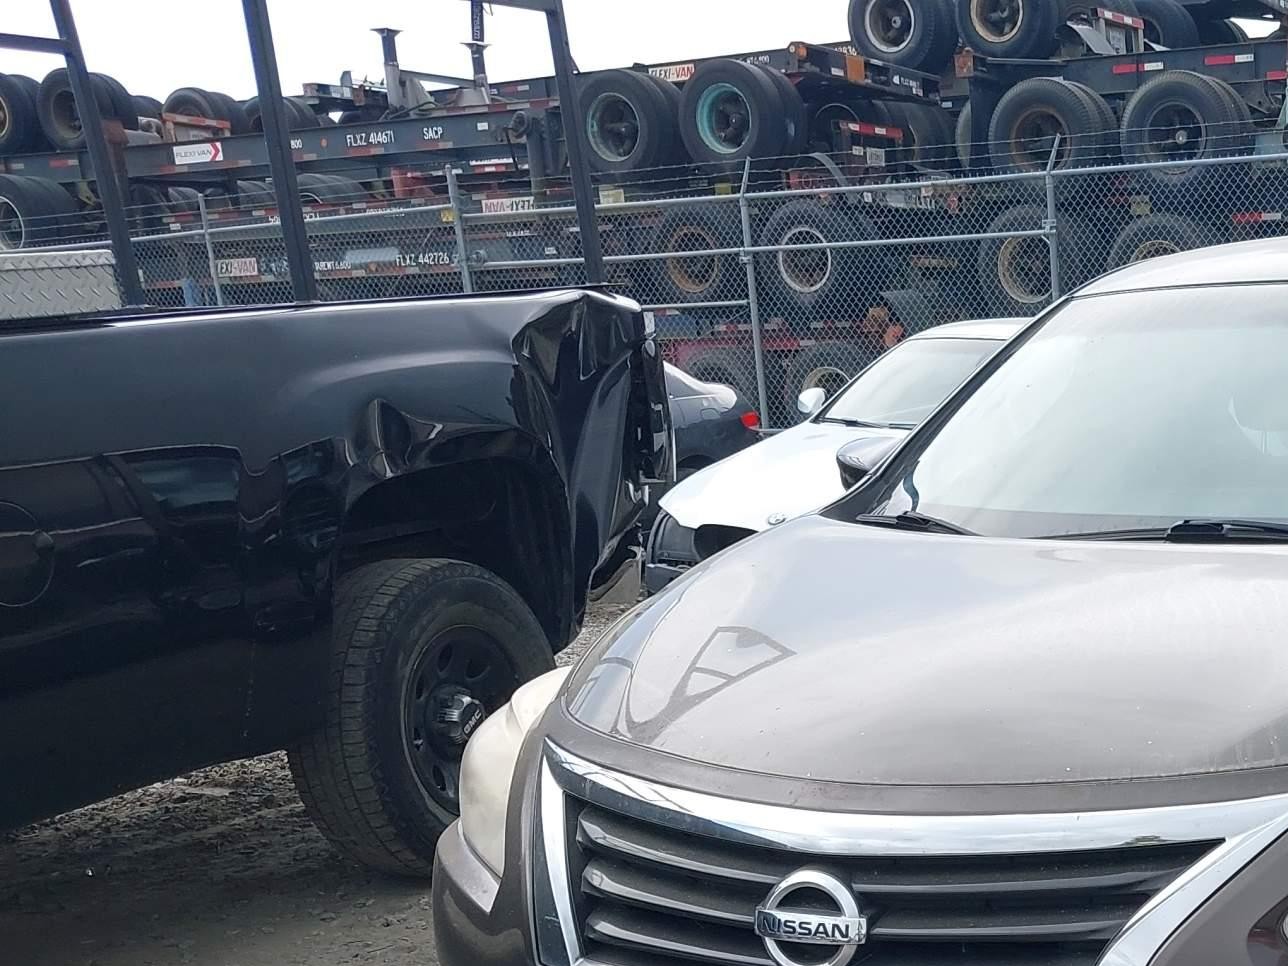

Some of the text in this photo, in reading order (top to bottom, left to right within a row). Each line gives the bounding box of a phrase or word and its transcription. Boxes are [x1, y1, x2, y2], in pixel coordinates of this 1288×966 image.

[346, 130, 394, 147] FLXZ 414671
[423, 127, 443, 140] SACP
[396, 253, 416, 267] FLXZ
[418, 252, 450, 265] 442726
[464, 709, 482, 734] GMC
[761, 914, 850, 940] NISSAN
